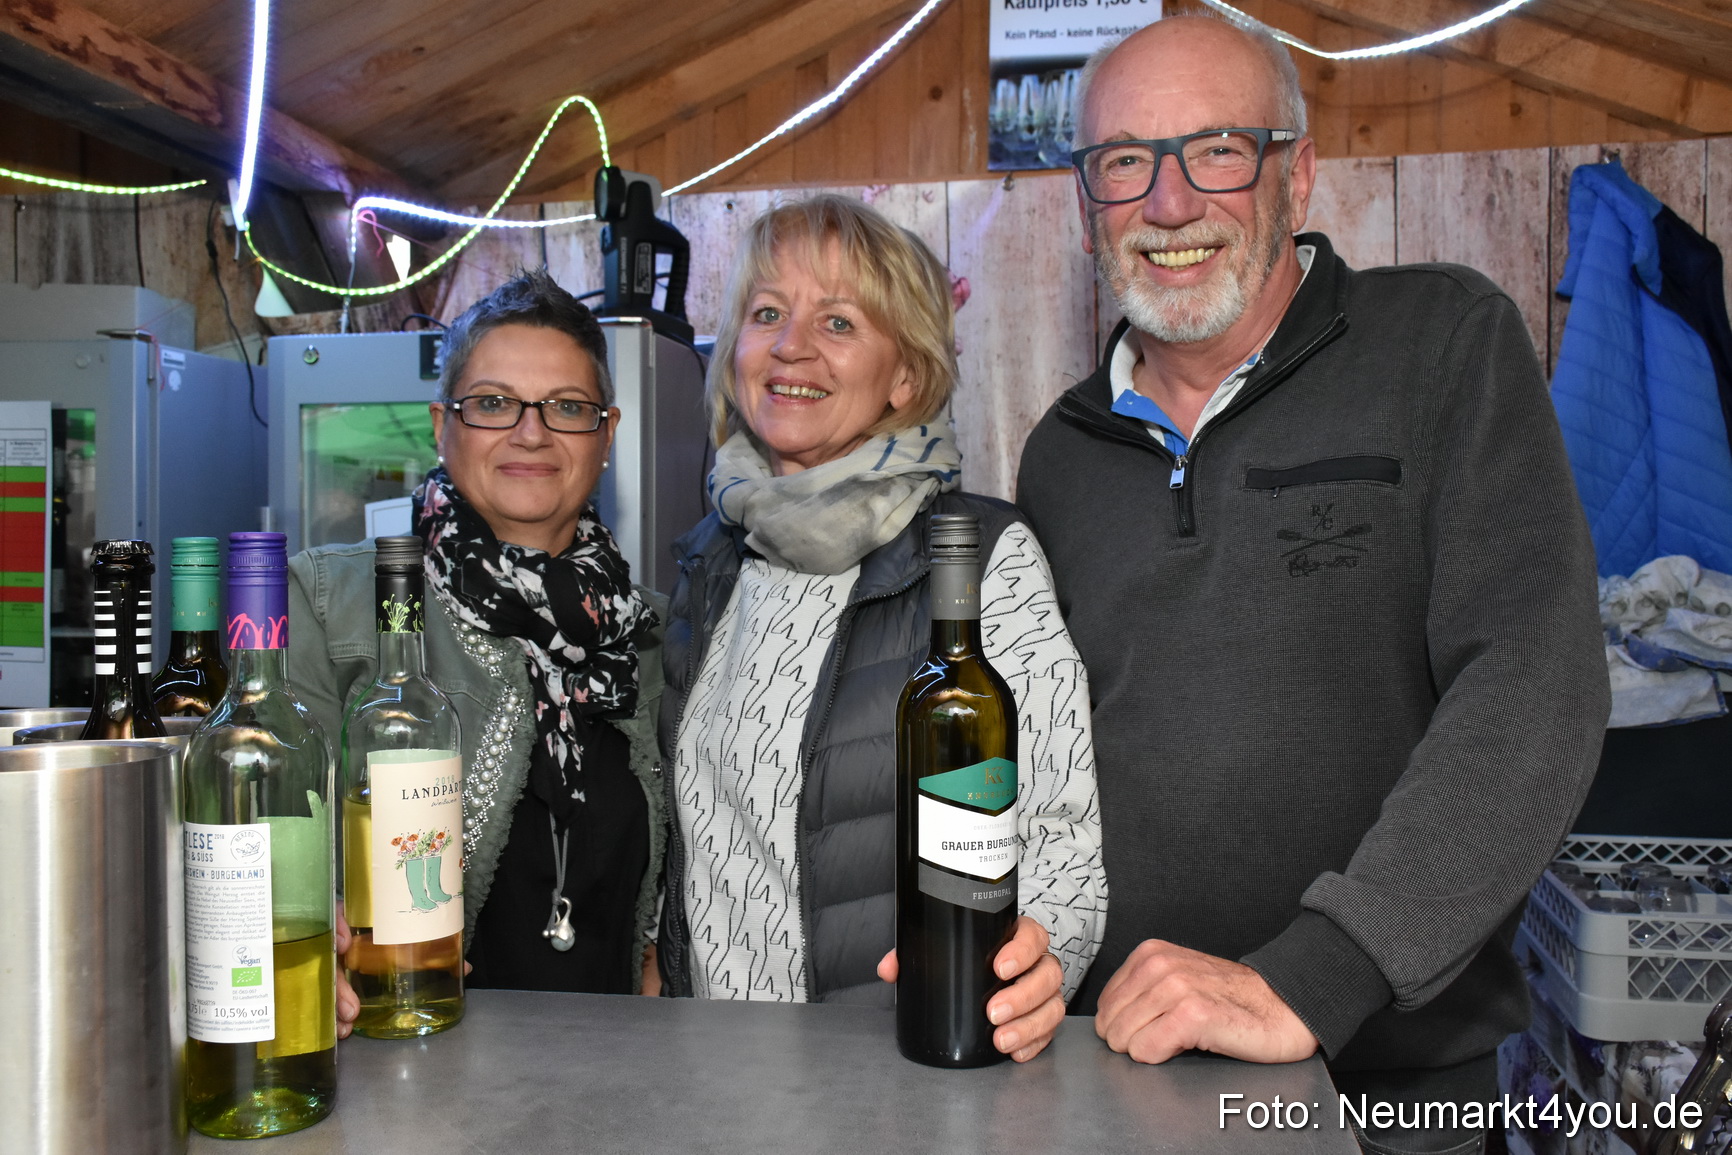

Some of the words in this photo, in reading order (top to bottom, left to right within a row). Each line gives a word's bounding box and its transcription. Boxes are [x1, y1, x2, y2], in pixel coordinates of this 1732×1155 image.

[1005, 30, 1026, 39] Kein
[1029, 29, 1057, 39] Pfand
[1067, 28, 1093, 37] keine
[941, 841, 984, 851] GRAUER
[197, 850, 214, 862] SÜSS
[979, 853, 1008, 862] TROCKEN
[210, 868, 265, 880] BURGENLAND
[972, 887, 1011, 900] FEUEROPAL
[214, 1007, 248, 1018] 10,5%
[251, 1006, 268, 1017] vol
